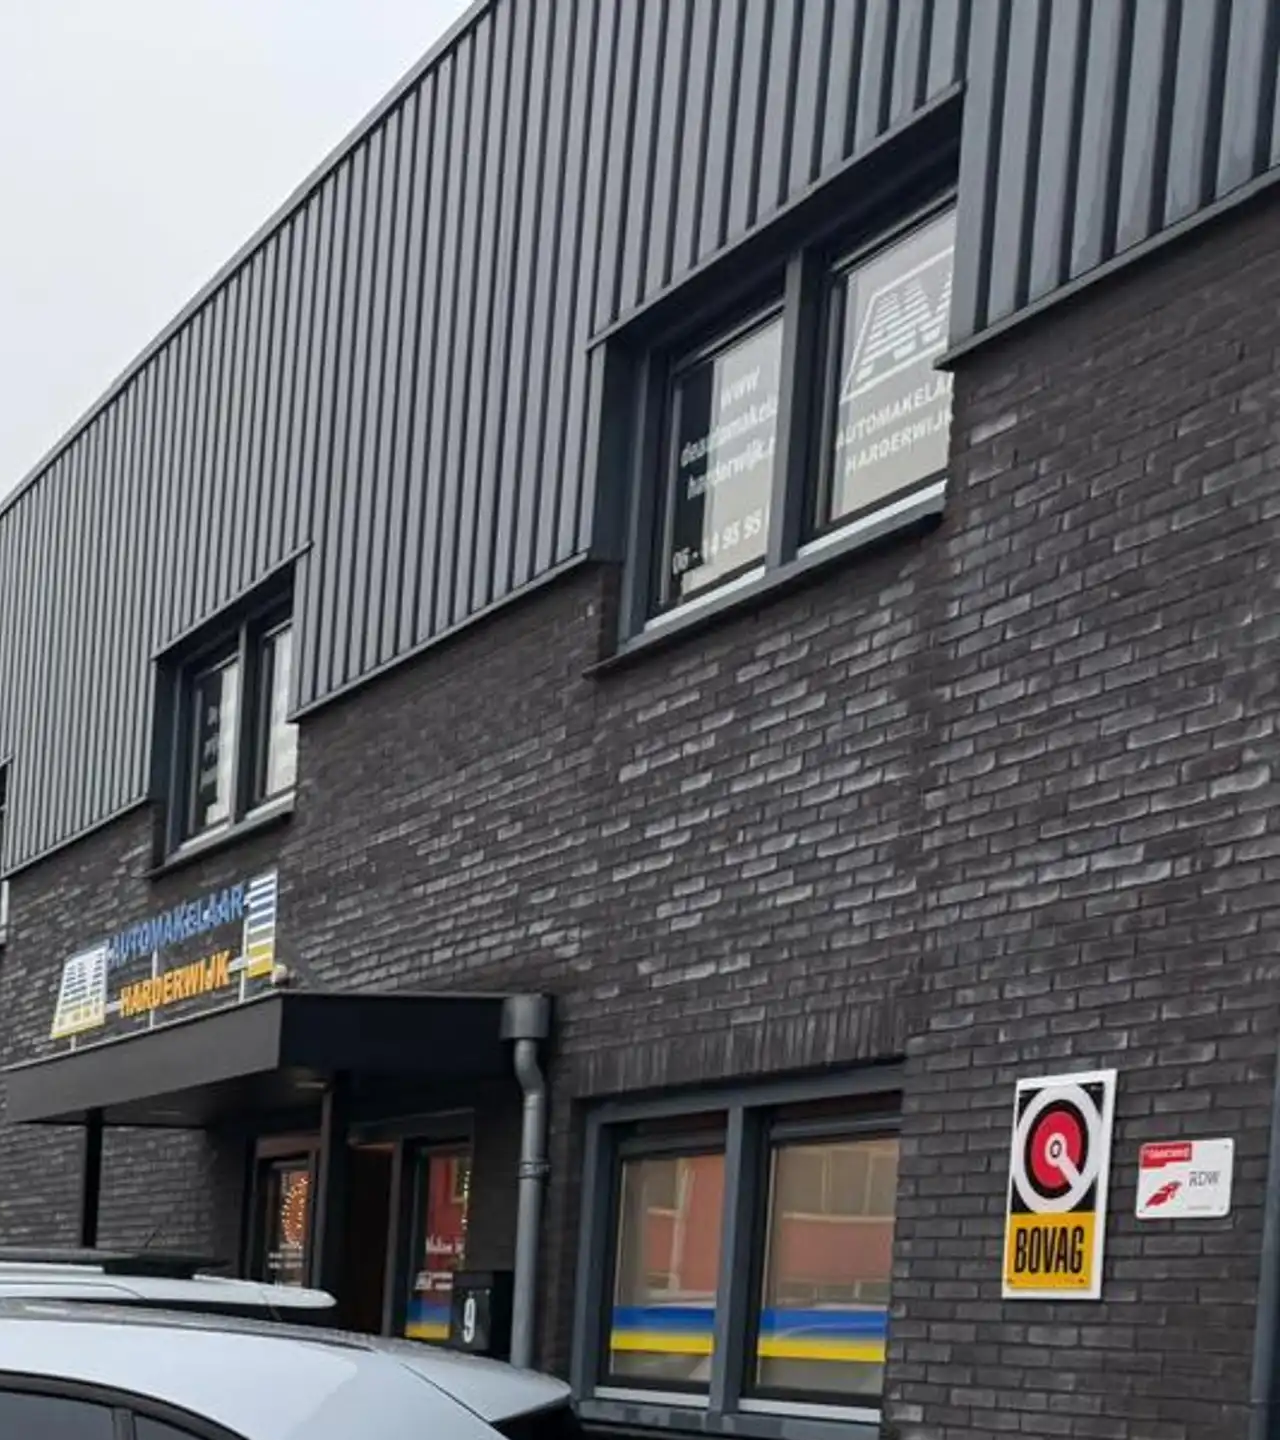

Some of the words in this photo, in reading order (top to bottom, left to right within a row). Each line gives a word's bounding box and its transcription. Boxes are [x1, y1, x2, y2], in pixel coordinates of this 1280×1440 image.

[110, 883, 245, 969] AUTOMAKELAAR
[119, 950, 231, 1018] HARDERWIJK
[1013, 1225, 1085, 1274] BOVAG
[462, 1297, 476, 1344] 9
